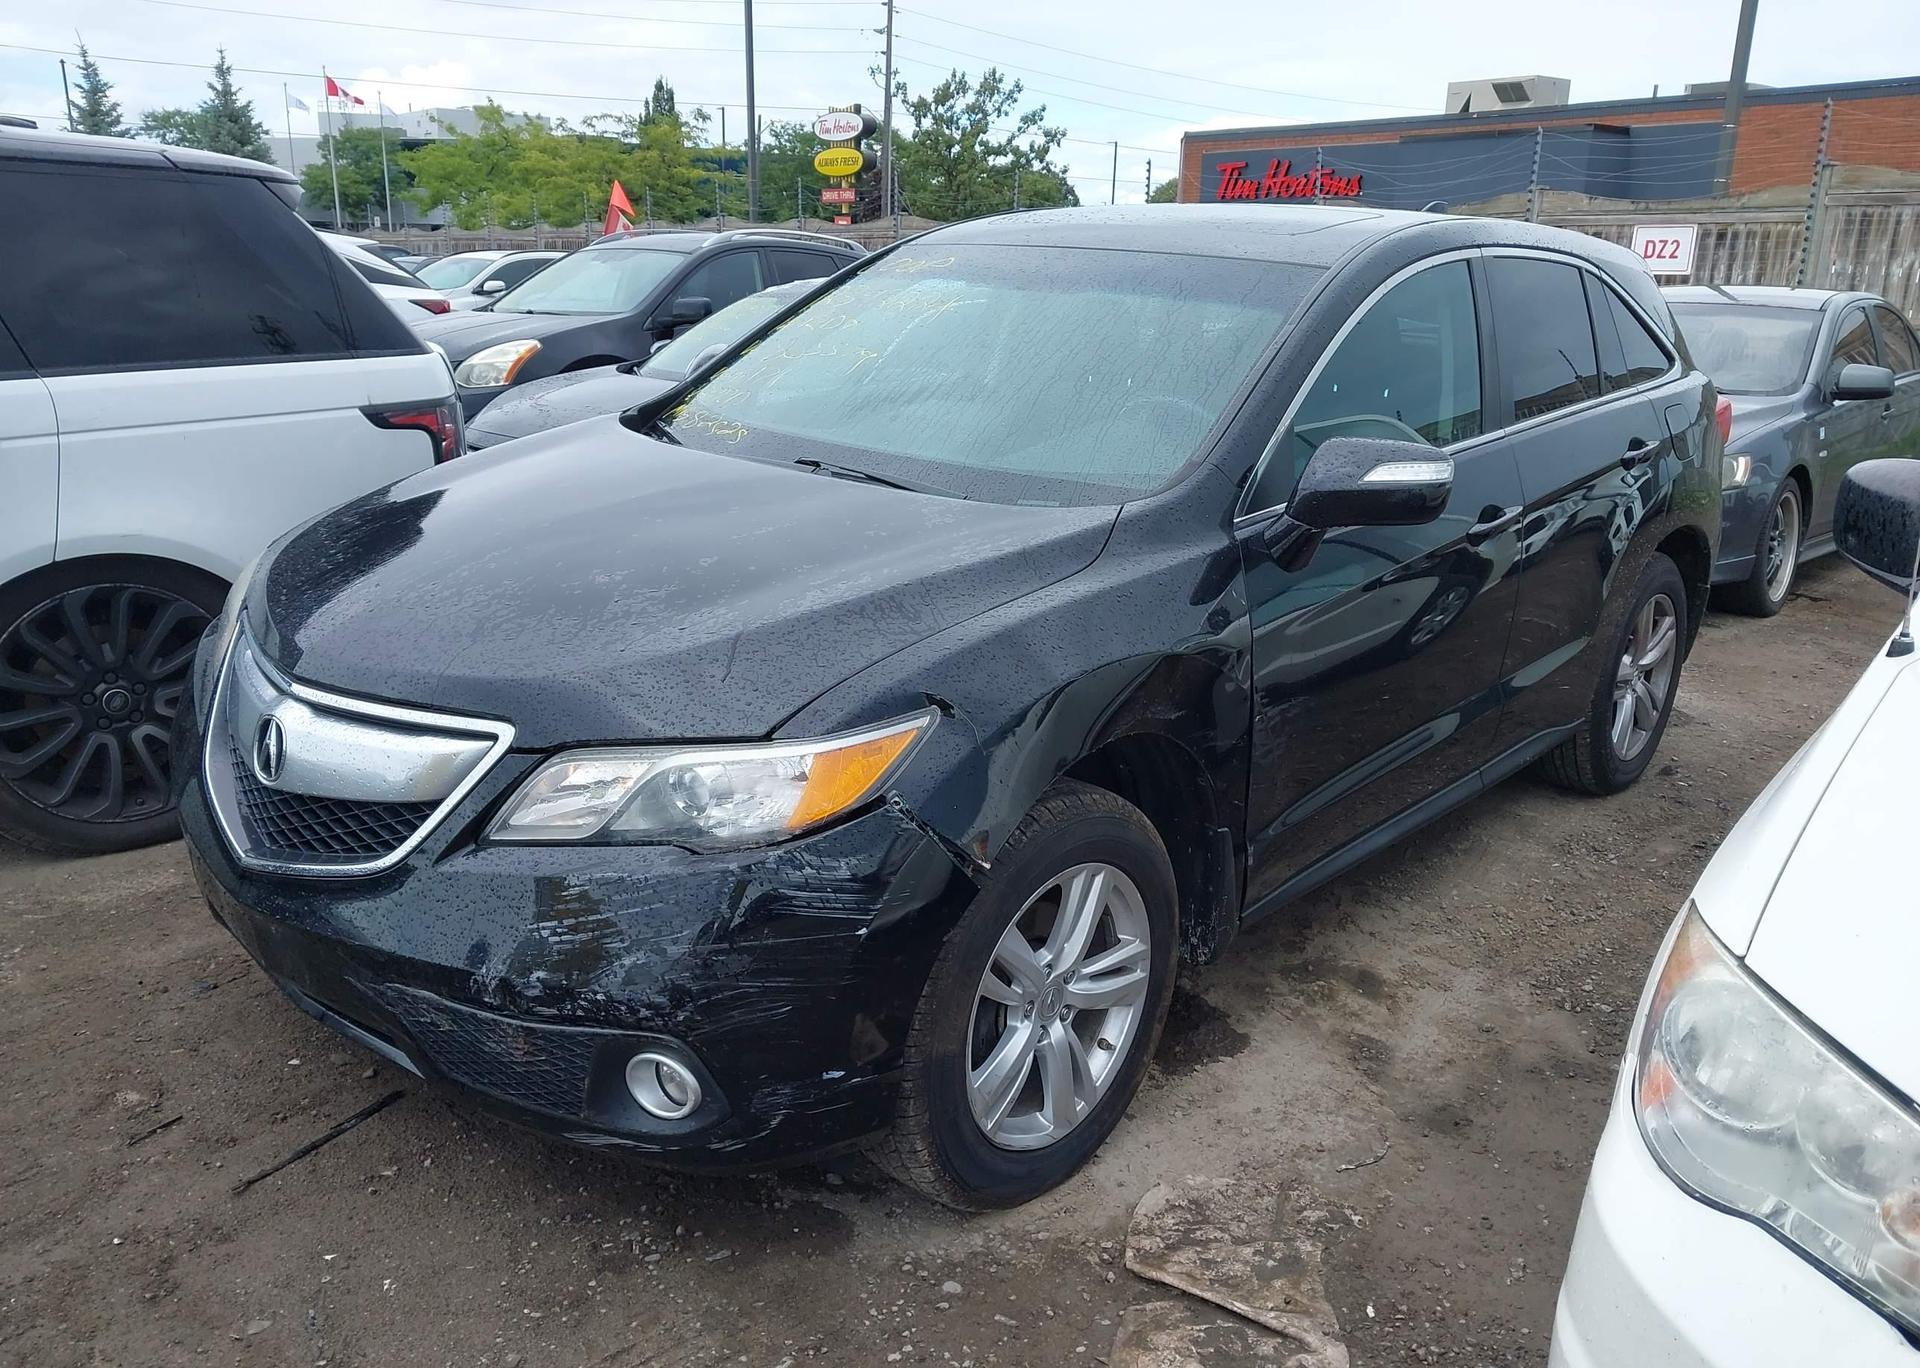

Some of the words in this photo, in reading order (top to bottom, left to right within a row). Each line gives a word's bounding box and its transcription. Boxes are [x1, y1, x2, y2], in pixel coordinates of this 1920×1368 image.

[819, 119, 832, 135] Tim
[832, 118, 859, 134] Hortons
[839, 156, 859, 167] FRESH
[1216, 161, 1260, 200] Tim
[1261, 158, 1363, 198] Hortons
[822, 191, 839, 200] DRIVE
[839, 190, 855, 200] THRU
[1643, 239, 1681, 259] DZ2
